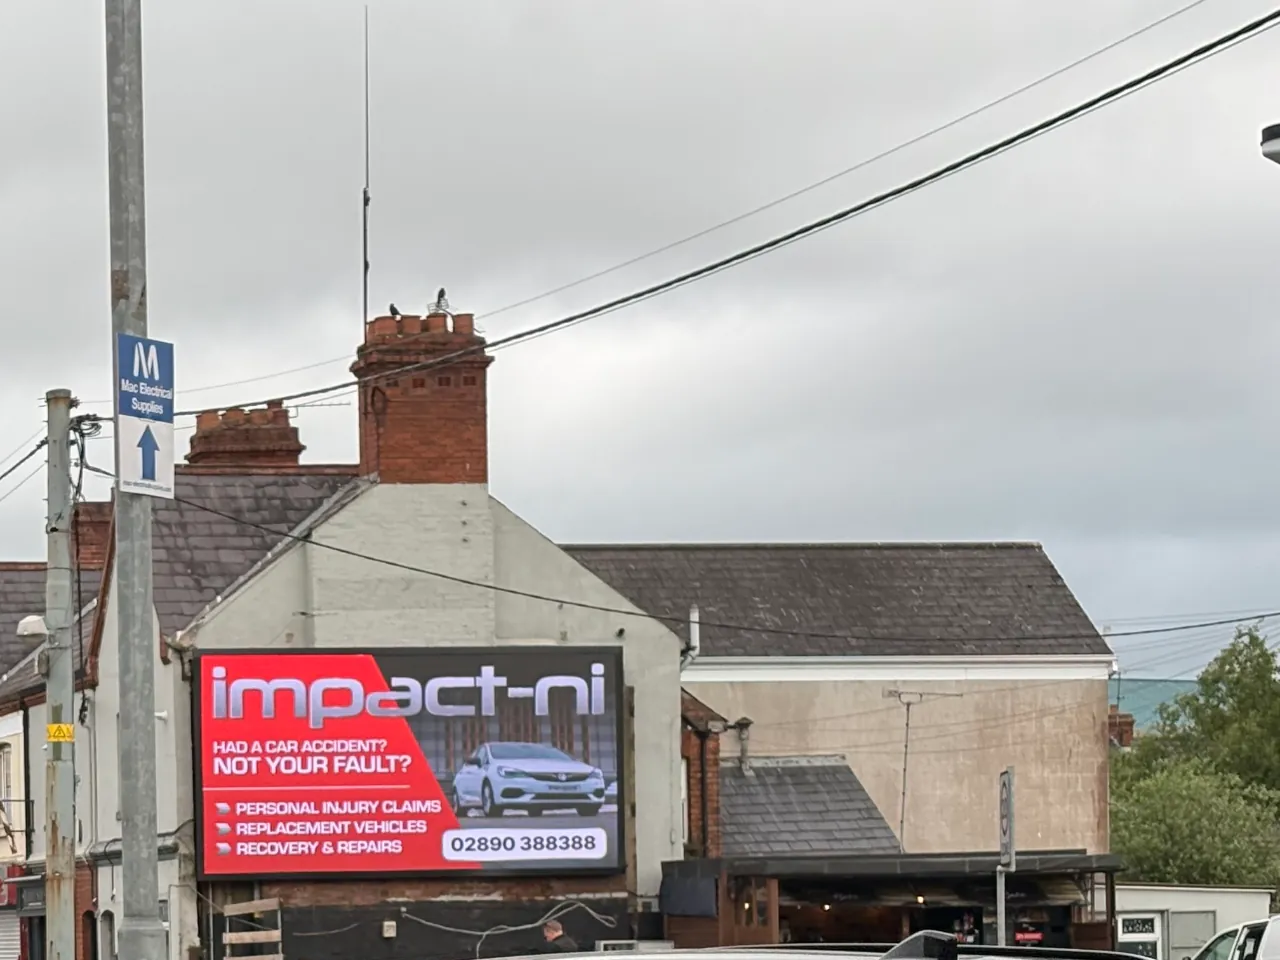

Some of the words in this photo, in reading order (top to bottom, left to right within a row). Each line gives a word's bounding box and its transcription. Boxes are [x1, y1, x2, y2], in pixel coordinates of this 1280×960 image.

[121, 378, 138, 394] Mac
[139, 382, 173, 399] Electrical
[131, 397, 164, 414] Supplies
[212, 663, 605, 729] impact-ni
[212, 740, 248, 754] HAD
[251, 740, 263, 754] A
[265, 740, 299, 754] CAR
[300, 739, 388, 753] ACCIDENT?
[213, 756, 262, 775] NOT
[266, 755, 328, 775] YOUR
[333, 754, 412, 774] FAULT?
[236, 802, 320, 816] PERSONAL
[322, 801, 380, 815] INJURY
[382, 800, 442, 814] CLAIMS
[236, 821, 352, 836] REPLACEMENT
[353, 820, 428, 834] VEHICLES
[236, 841, 320, 856] RECOVERY
[322, 841, 335, 855] &
[337, 840, 403, 854] REPAIRS
[451, 836, 516, 852] 02890
[520, 835, 596, 850] 388388
